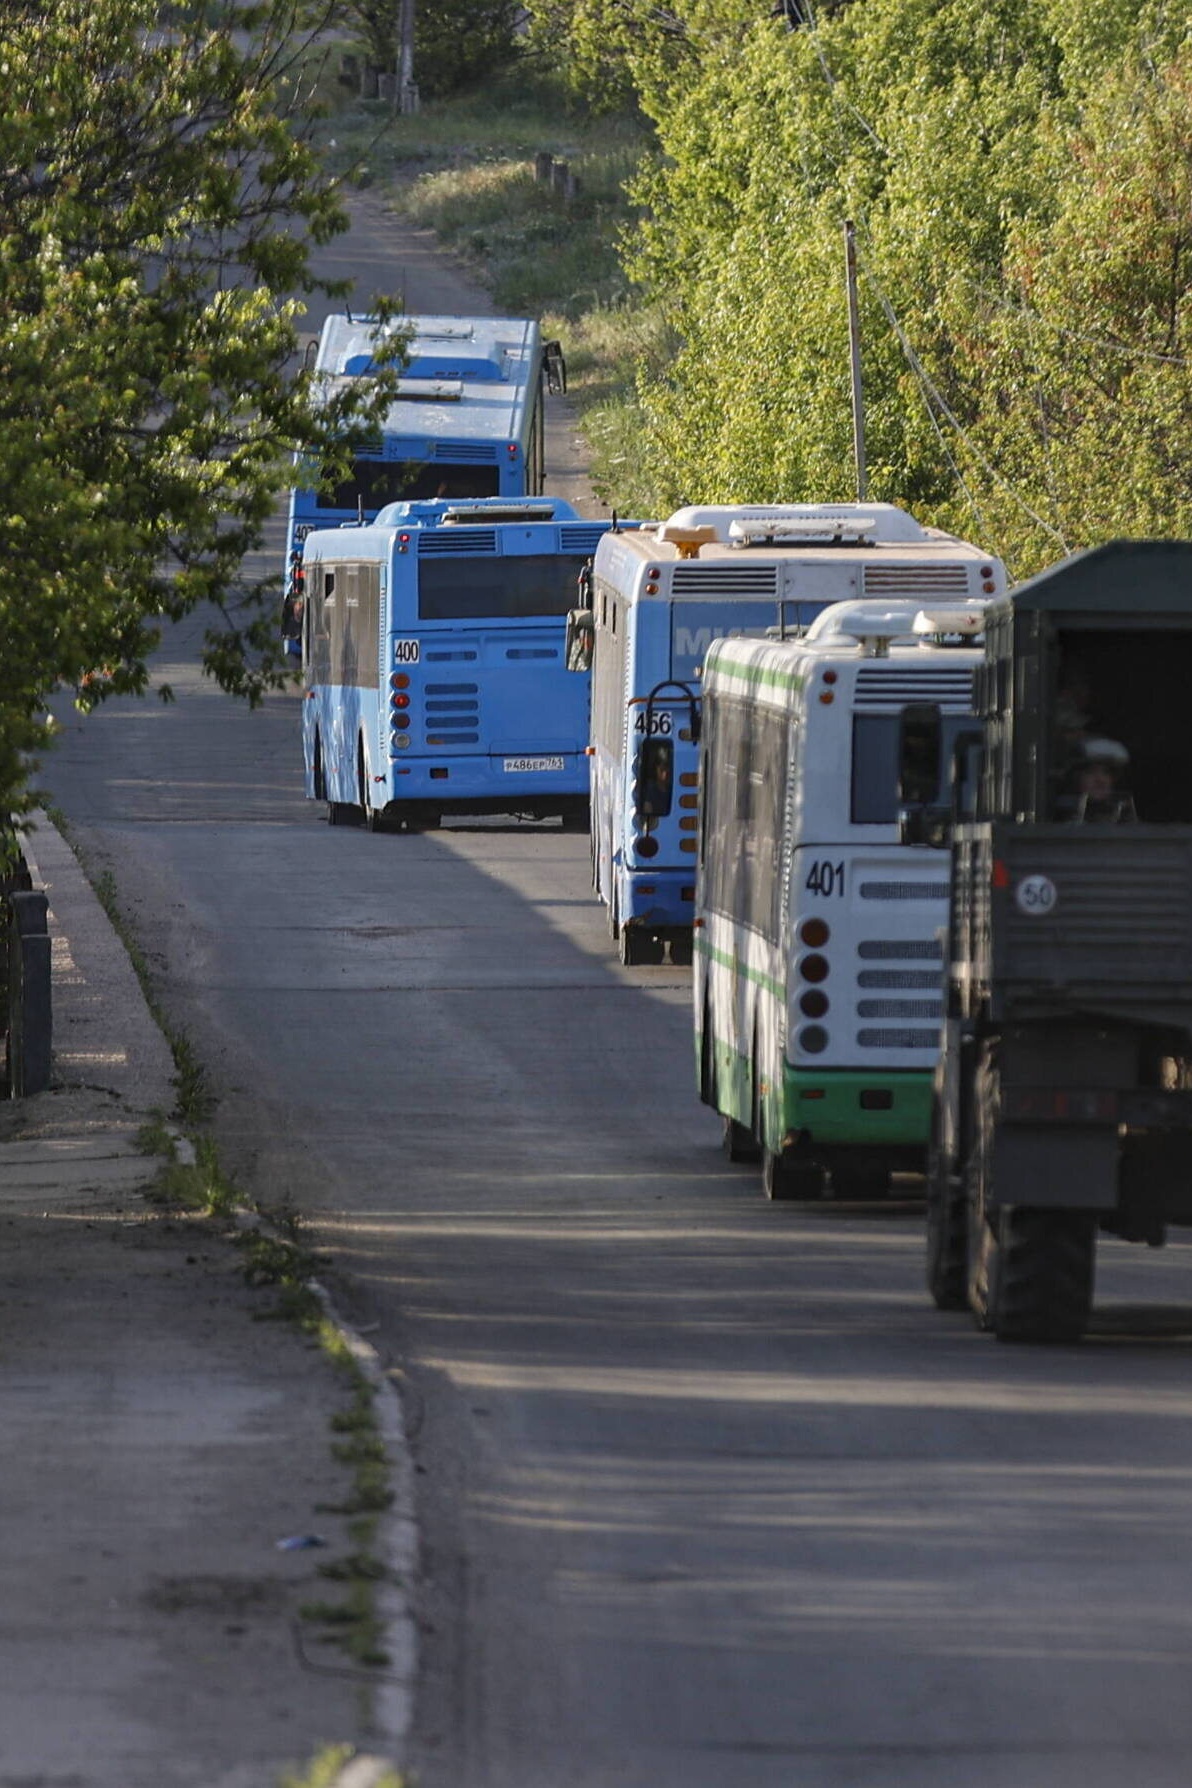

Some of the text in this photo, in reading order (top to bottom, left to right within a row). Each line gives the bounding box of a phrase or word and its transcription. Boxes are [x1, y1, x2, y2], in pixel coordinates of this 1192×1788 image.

[396, 641, 419, 661] 400
[635, 712, 672, 735] 456
[806, 860, 845, 897] 401
[1025, 882, 1051, 906] 50
